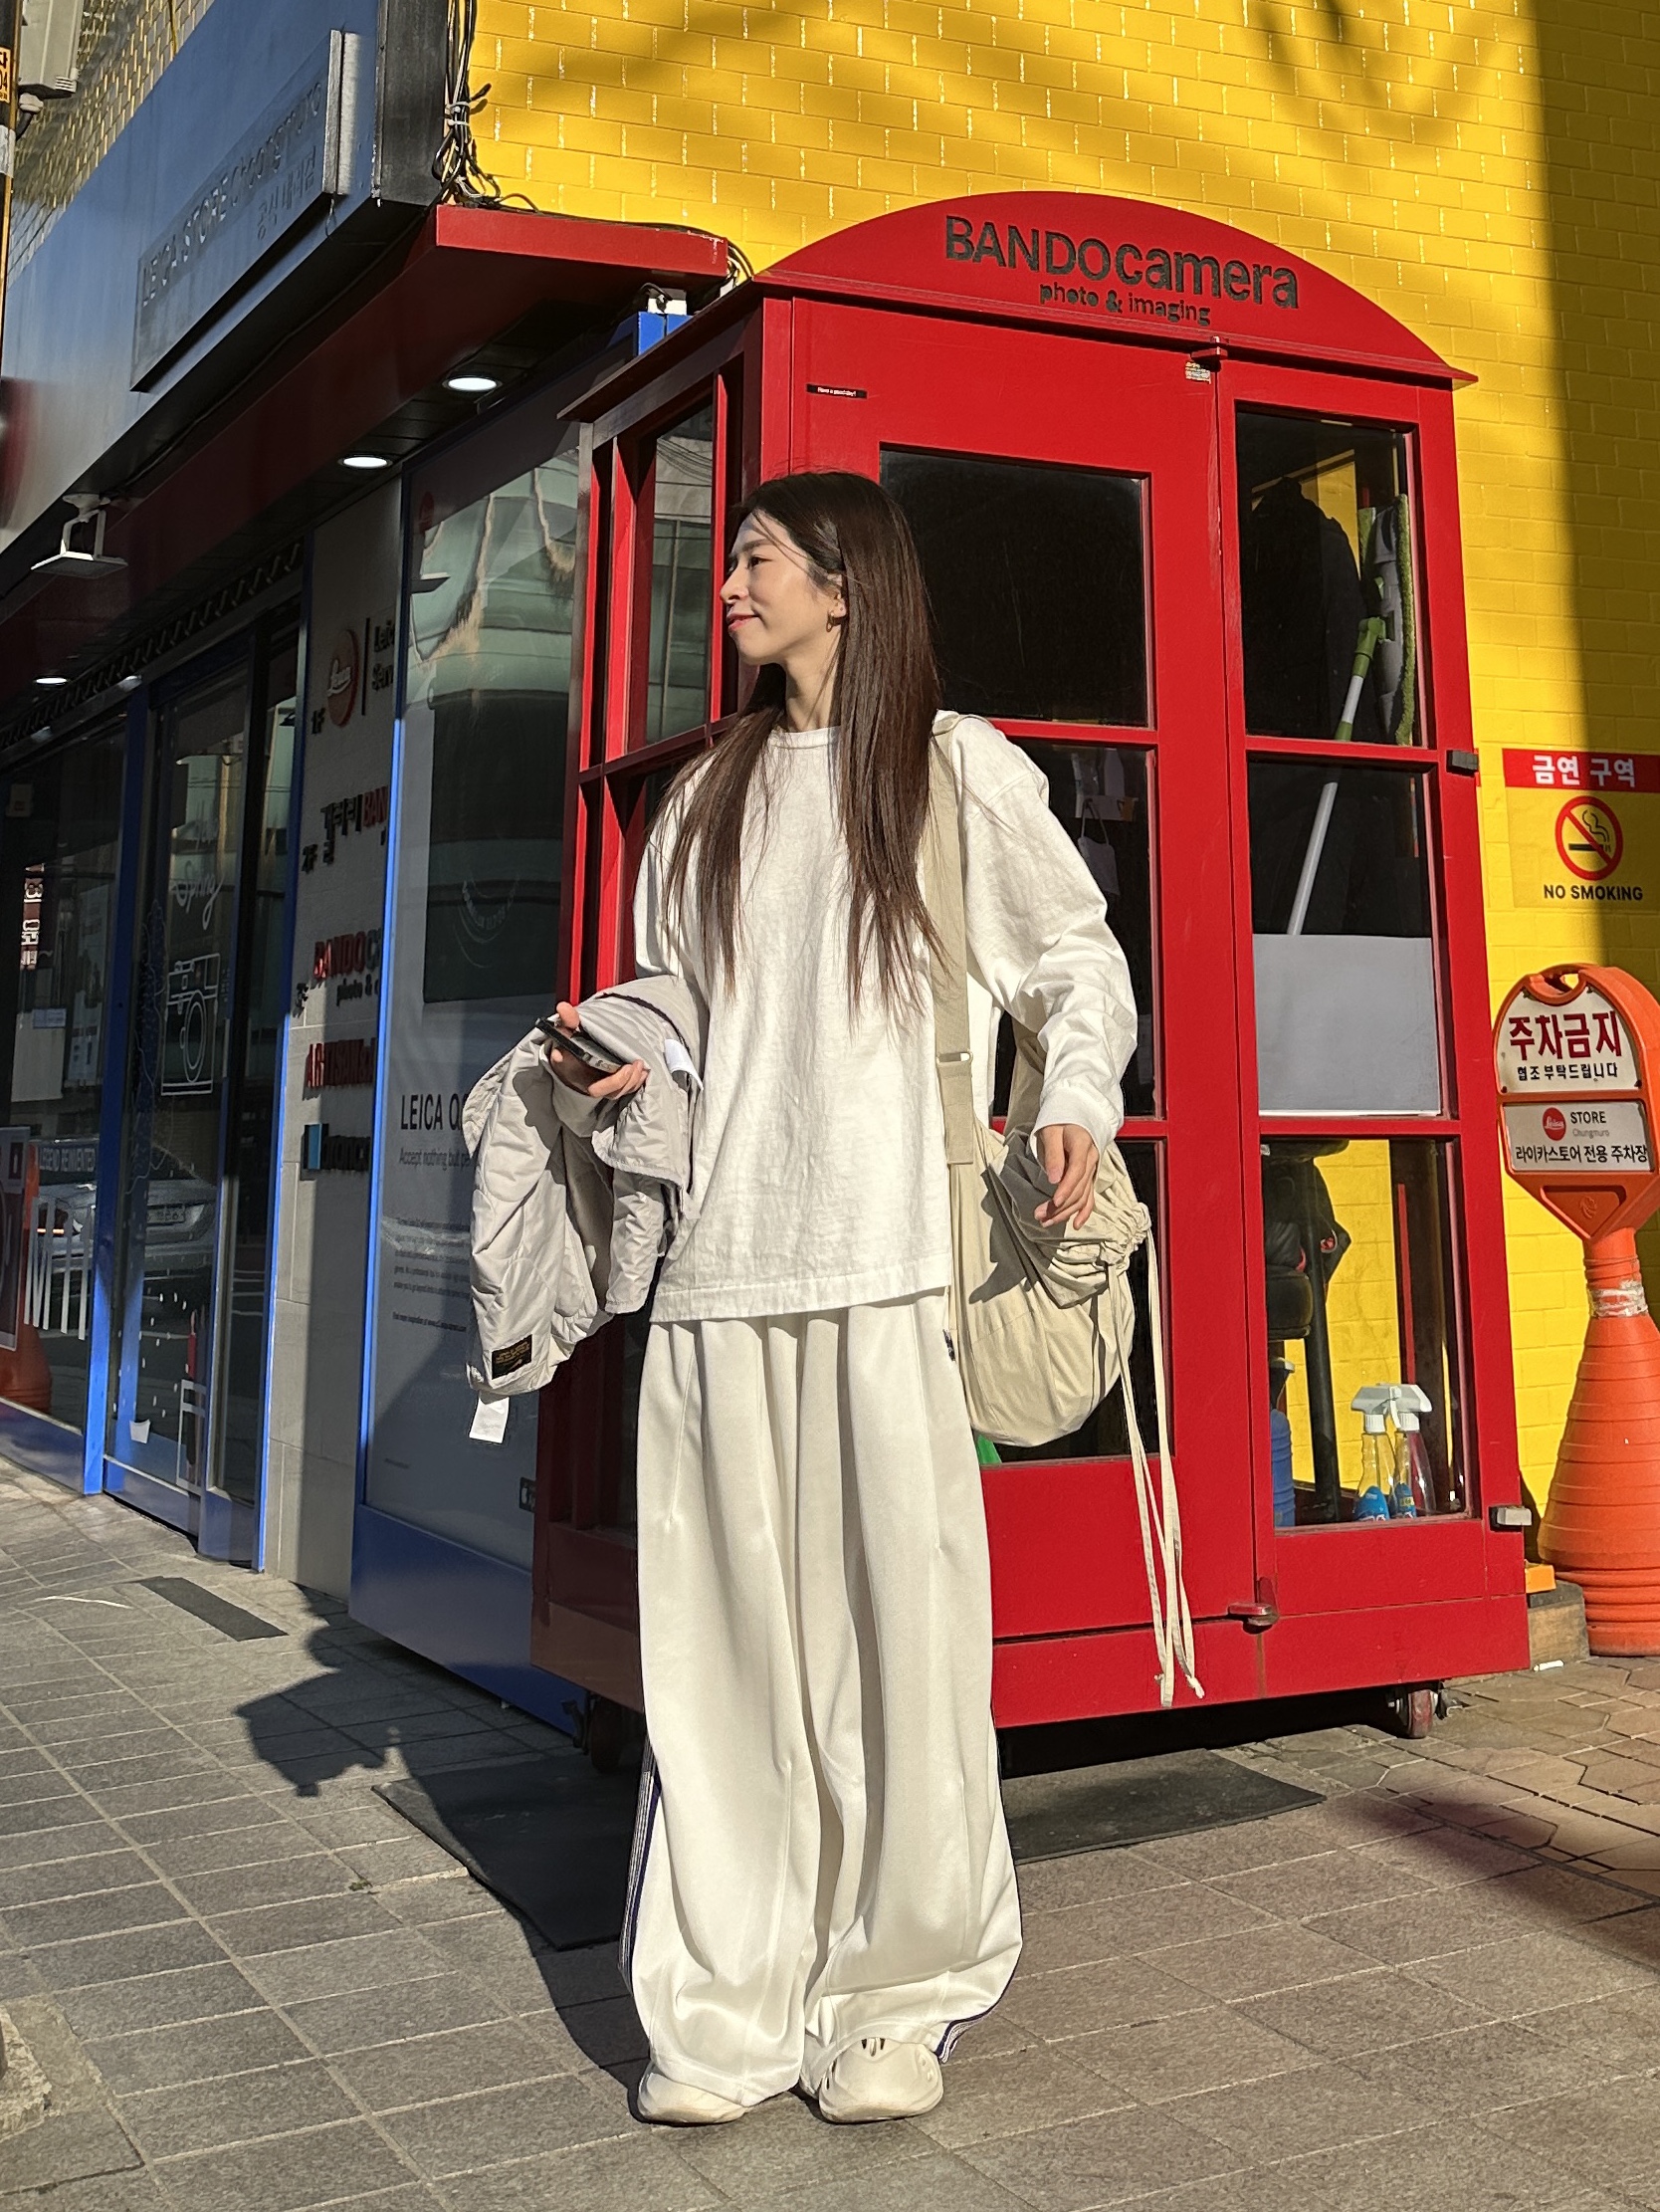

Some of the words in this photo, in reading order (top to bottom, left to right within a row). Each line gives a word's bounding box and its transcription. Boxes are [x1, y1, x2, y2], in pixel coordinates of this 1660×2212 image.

[944, 215, 1299, 309] BANDOcamera
[1039, 282, 1099, 307] photo
[1105, 289, 1124, 313] &
[1128, 293, 1211, 326] imaging
[1533, 755, 1580, 785] 금연
[1590, 758, 1635, 787] 구역
[1543, 884, 1565, 899] NO
[1570, 885, 1643, 901] SMOKING
[1509, 1010, 1622, 1060] 주차금지
[1517, 1066, 1541, 1081] 협조
[1544, 1062, 1618, 1079] 부탁드립니다
[400, 1093, 443, 1131] LEICA
[1569, 1111, 1607, 1124] STORE
[1515, 1145, 1581, 1163] 라이카스토어
[1583, 1145, 1608, 1163] 전용
[1610, 1145, 1648, 1163] 주차장
